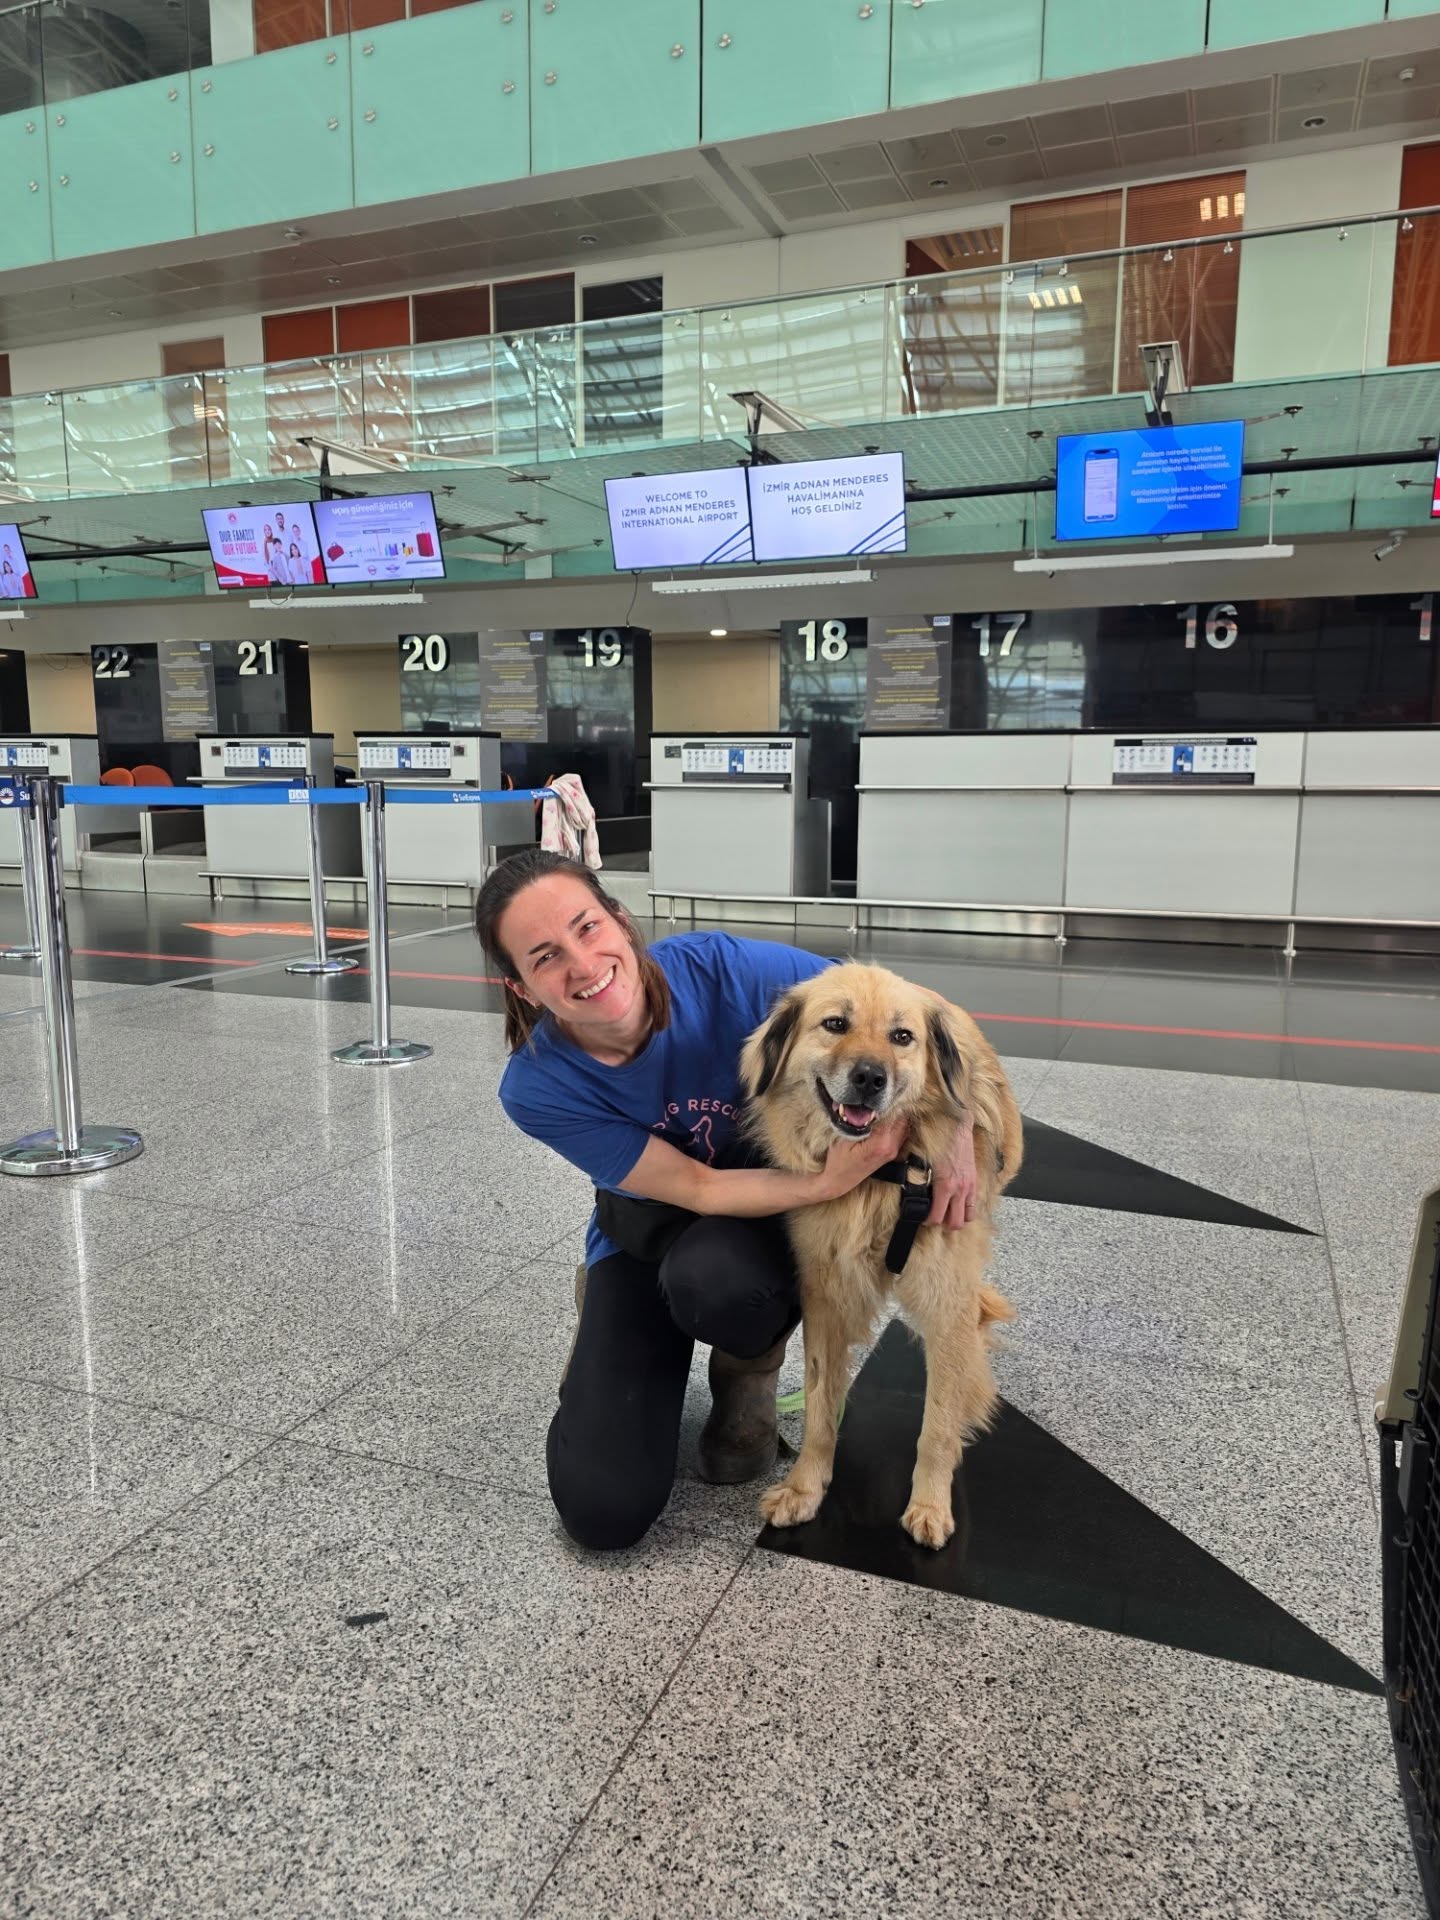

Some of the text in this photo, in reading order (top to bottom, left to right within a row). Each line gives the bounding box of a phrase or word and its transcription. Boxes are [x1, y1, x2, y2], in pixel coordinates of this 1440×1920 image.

[793, 478, 830, 490] ADNAN
[833, 473, 889, 487] MENDERES
[645, 490, 708, 503] WELCOME TO
[649, 504, 683, 516] ADNAN
[685, 499, 736, 512] MENDERES
[787, 488, 864, 503] HAVALİMANINA
[791, 501, 862, 516] HOŞ GELDİNİZ
[621, 511, 739, 529] INTERNATIONAL AIRPORT
[219, 528, 255, 543] OUR FAMILY
[222, 543, 235, 556] OUR
[1177, 603, 1238, 650] 16
[1410, 594, 1433, 640] 1
[798, 620, 848, 661] 18
[971, 613, 1026, 656] 17
[238, 640, 274, 676] 21
[402, 634, 448, 672] 20
[577, 629, 622, 668] 19
[94, 645, 131, 679] 22
